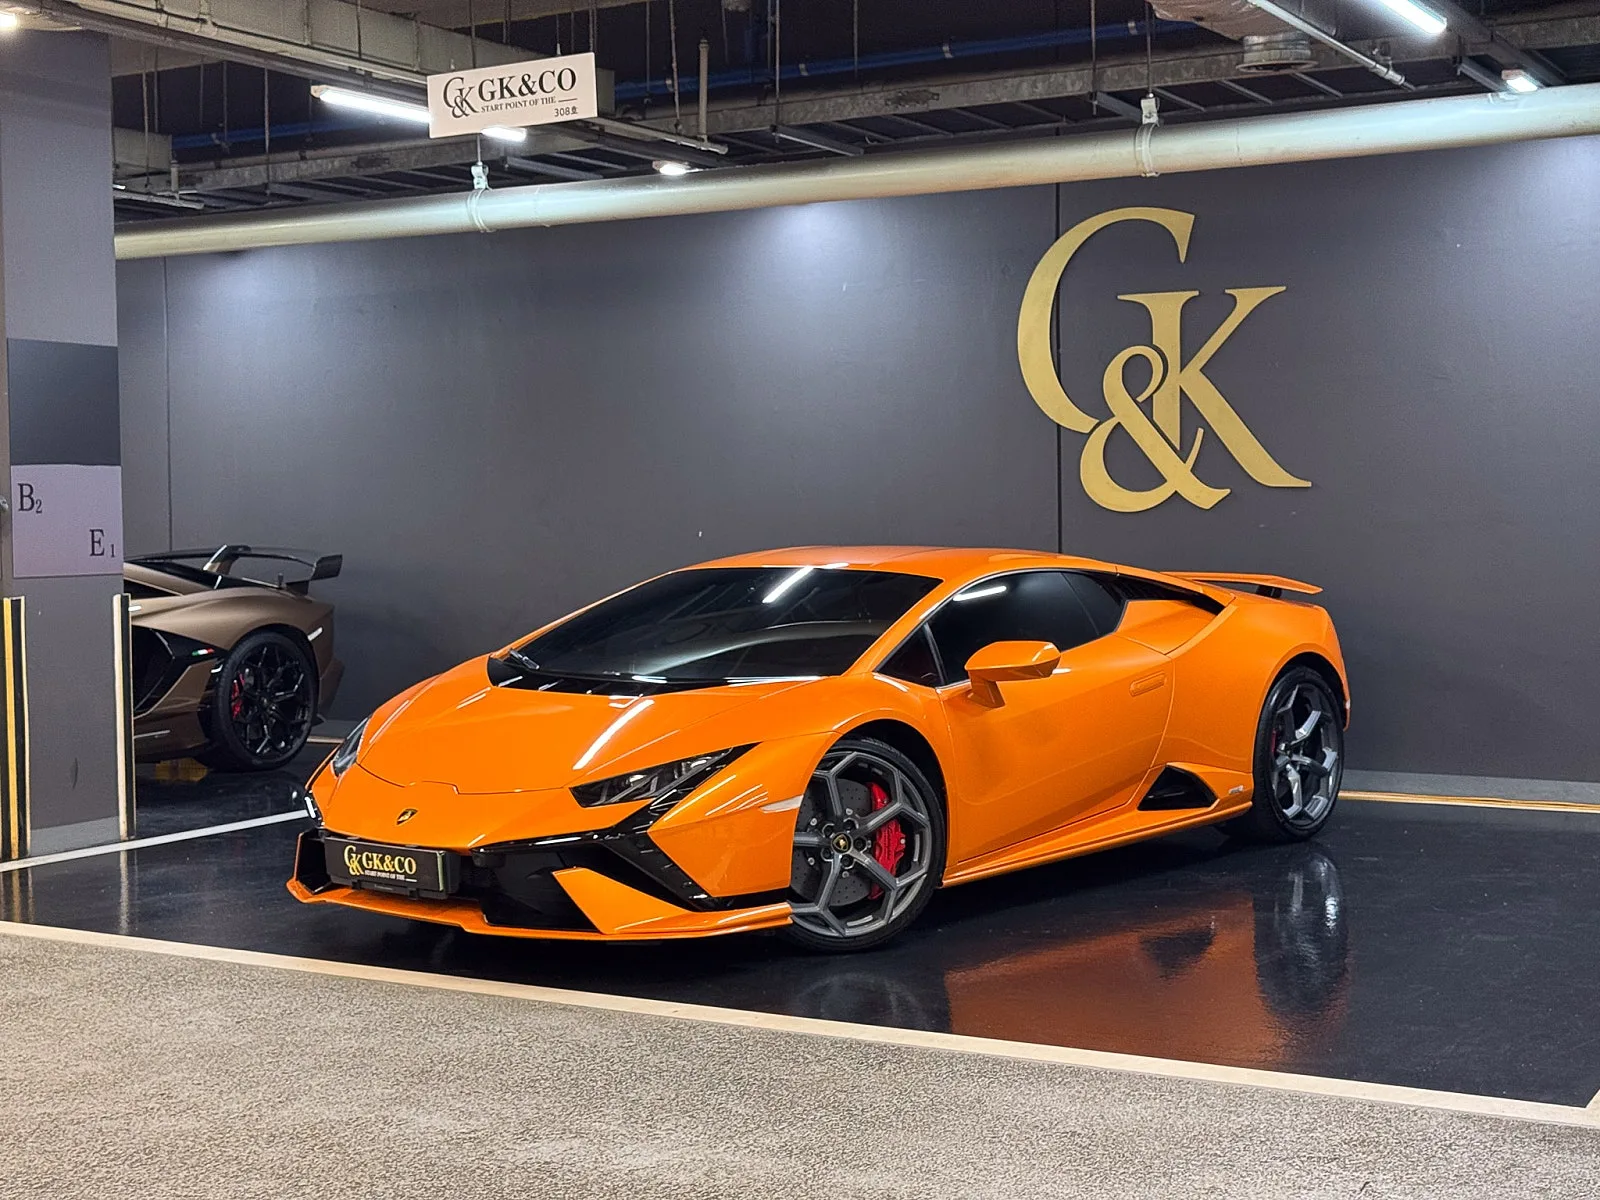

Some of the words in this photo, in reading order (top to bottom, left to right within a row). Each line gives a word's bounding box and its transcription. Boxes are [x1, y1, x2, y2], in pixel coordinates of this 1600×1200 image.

[478, 67, 577, 103] GK&CO
[481, 103, 504, 113] START
[505, 100, 528, 110] POINT
[529, 99, 539, 107] OF
[540, 96, 556, 105] THE
[362, 851, 417, 875] GK&CO
